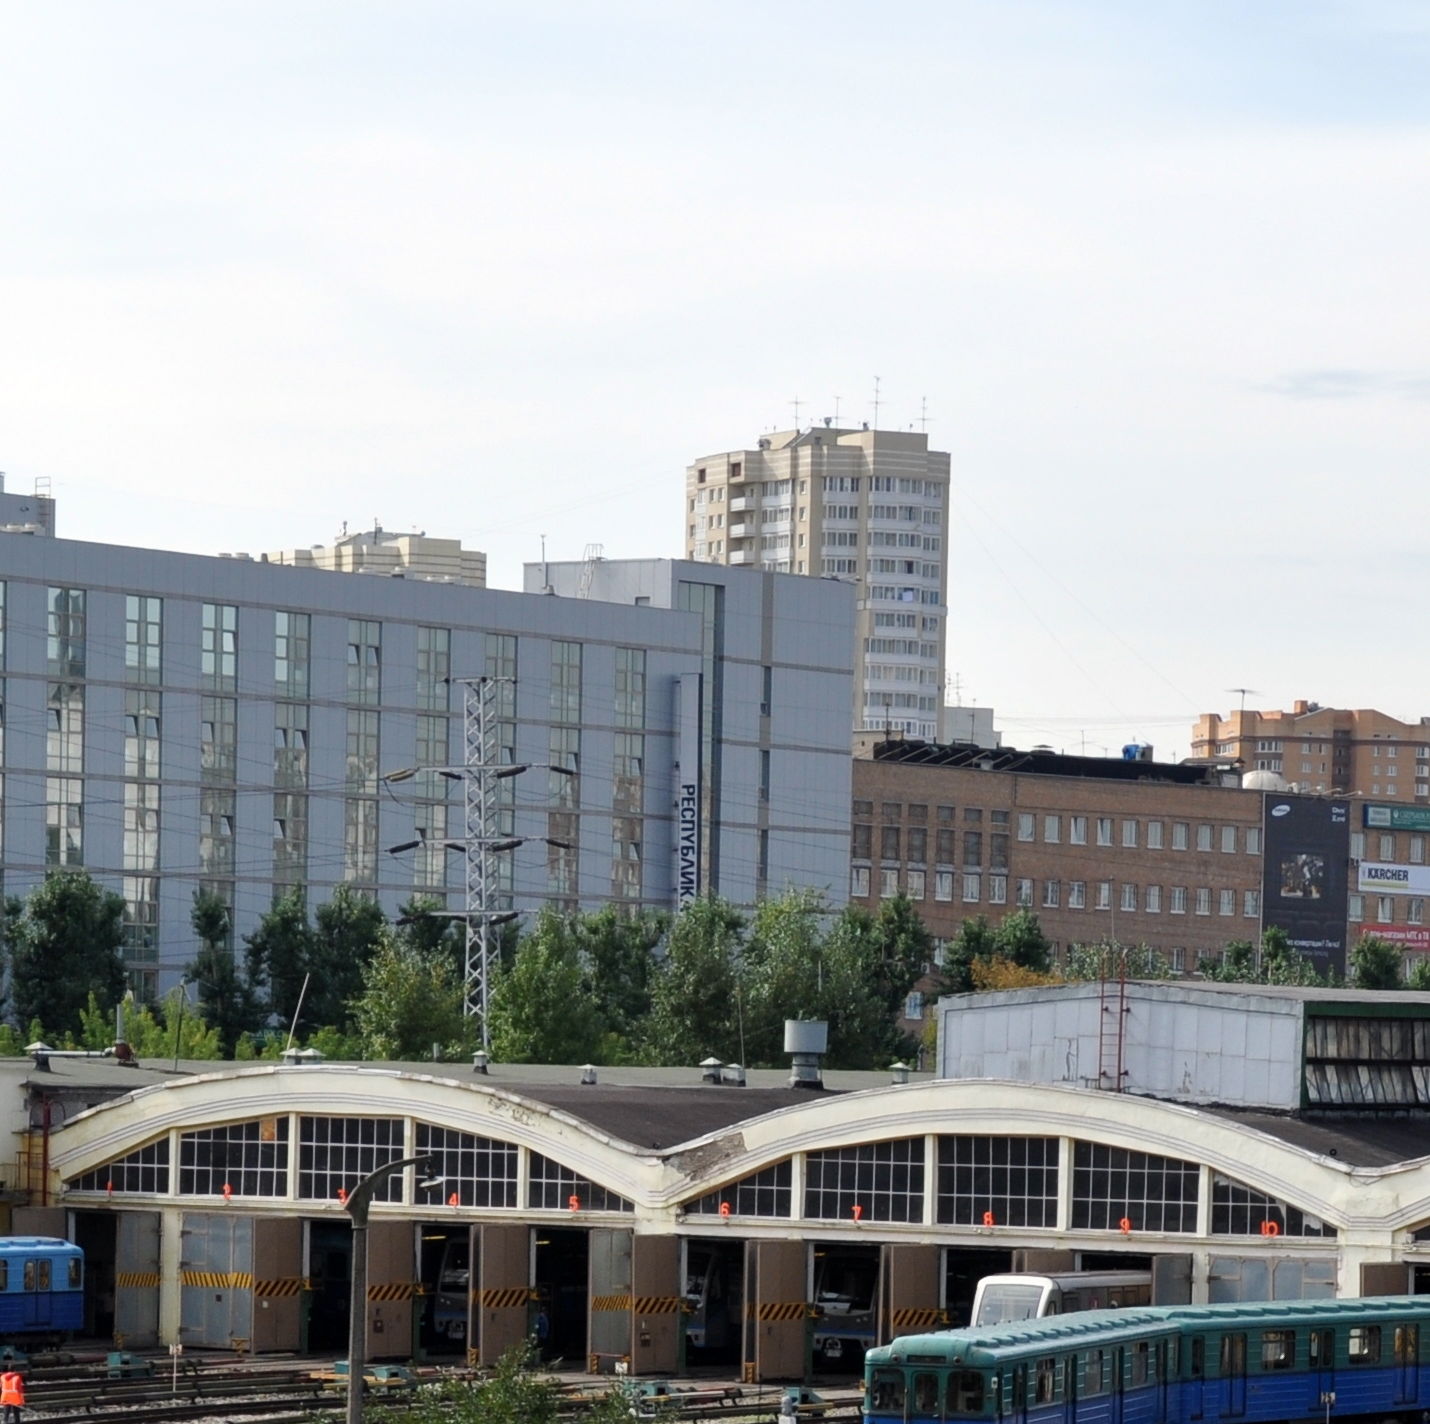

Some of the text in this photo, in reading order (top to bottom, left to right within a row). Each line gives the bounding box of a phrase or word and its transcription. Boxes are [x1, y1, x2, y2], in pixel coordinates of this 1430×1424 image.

[223, 1184, 231, 1200] 2
[449, 1193, 459, 1207] 4
[569, 1195, 579, 1211] 5
[720, 1203, 729, 1217] 6
[852, 1206, 862, 1221] 7
[983, 1212, 994, 1227] 8
[1120, 1218, 1129, 1234] 9
[1261, 1222, 1279, 1237] 10
